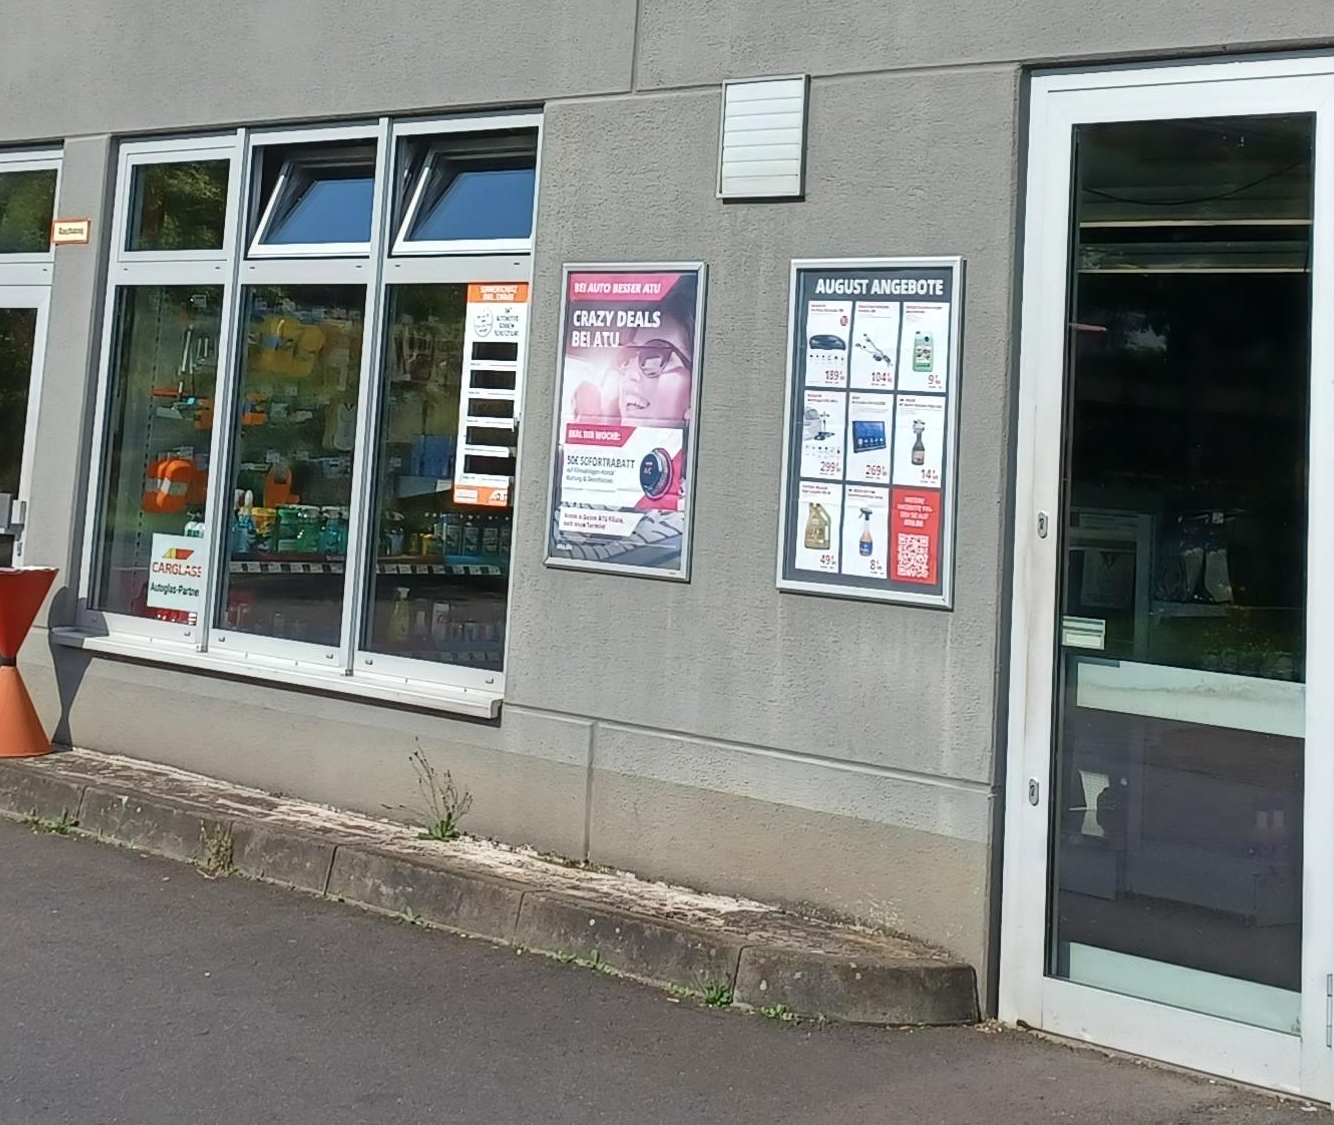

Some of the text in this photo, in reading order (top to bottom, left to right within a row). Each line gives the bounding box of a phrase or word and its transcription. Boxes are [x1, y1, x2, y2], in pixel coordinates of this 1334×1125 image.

[613, 283, 641, 293] BESSER
[642, 283, 661, 294] ATU
[815, 278, 944, 295] AUGUST ANGEBOTE
[573, 310, 661, 328] CRAZY DEALS
[571, 331, 620, 348] BEI ATU
[580, 456, 635, 469] SOFORTRABATT
[151, 581, 200, 597] Autoglas-Partne
